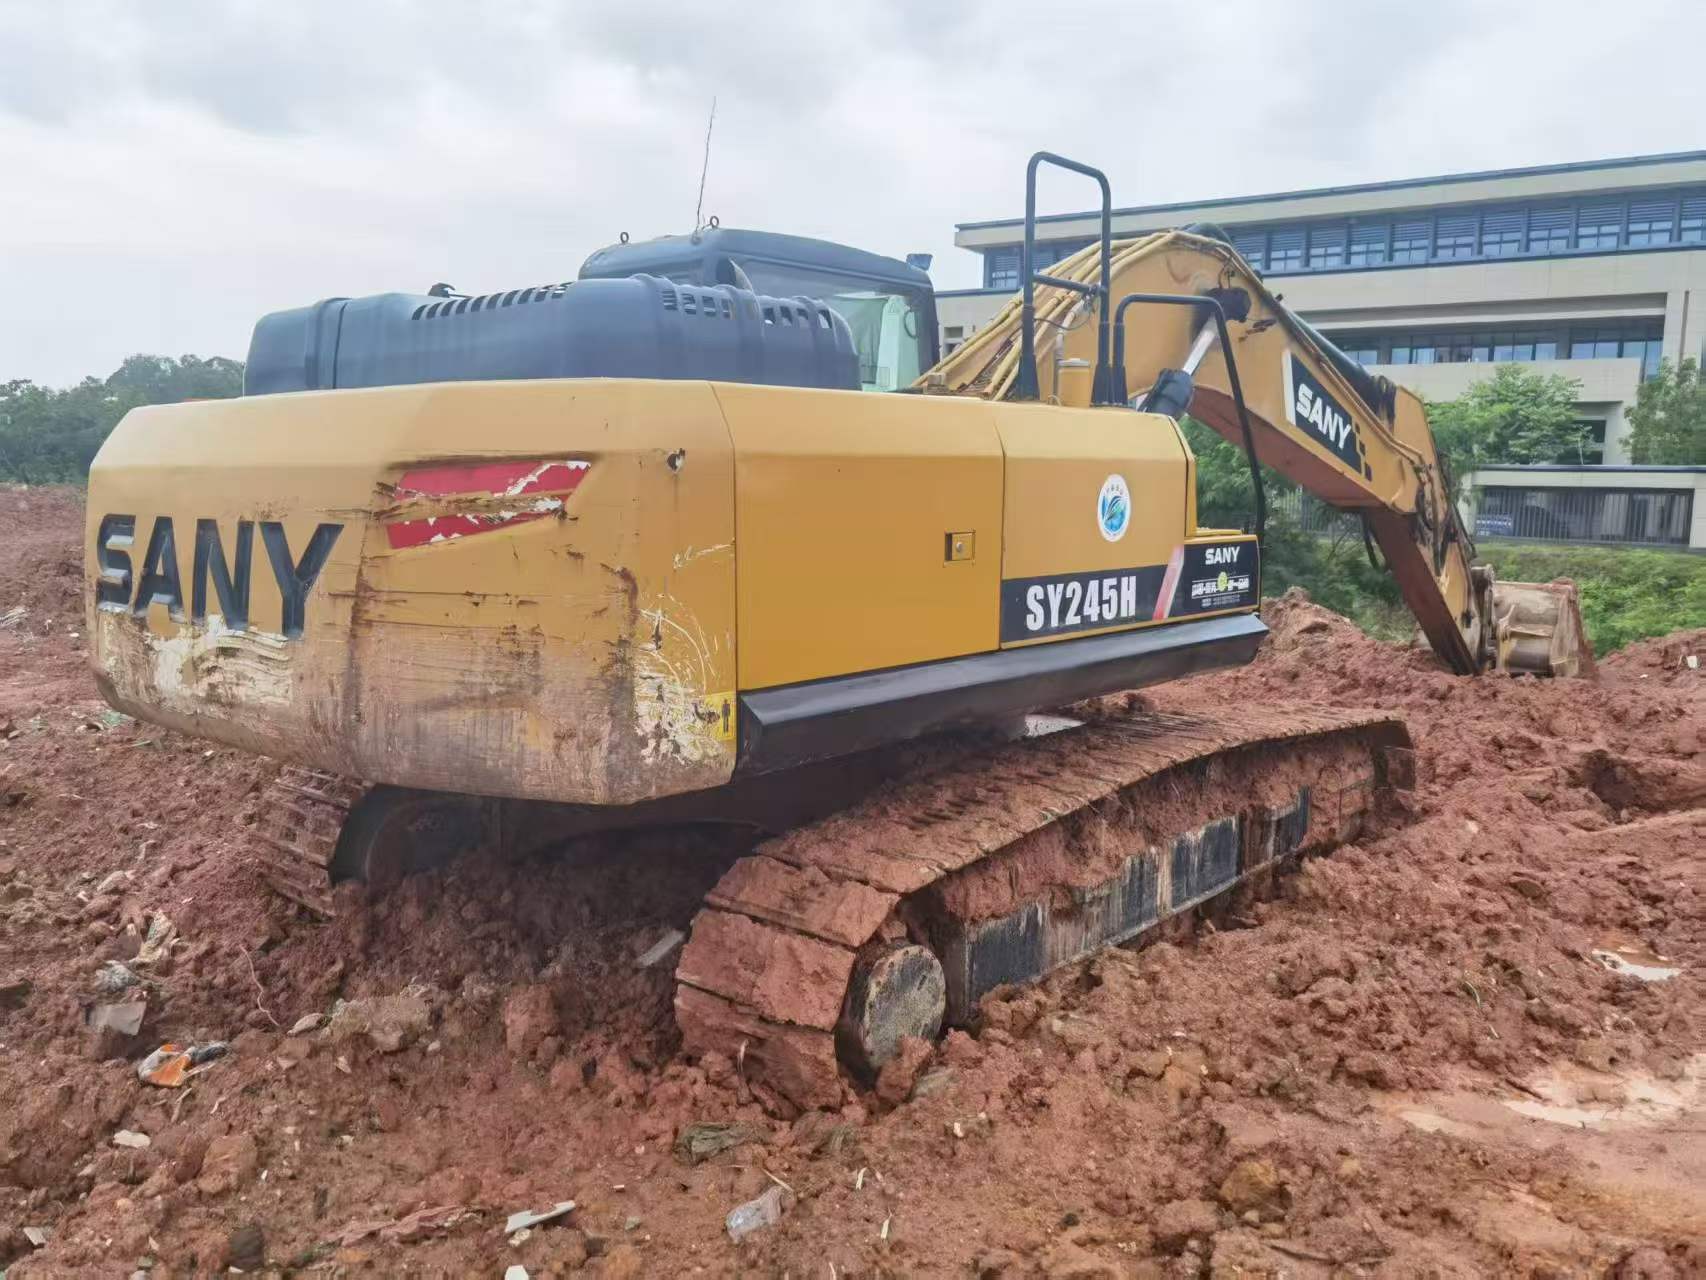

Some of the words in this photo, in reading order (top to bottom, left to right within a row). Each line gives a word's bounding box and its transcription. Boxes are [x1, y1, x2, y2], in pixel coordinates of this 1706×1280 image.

[1296, 383, 1352, 450] SANY
[96, 513, 344, 639] SANY
[1205, 546, 1240, 566] SANY
[1026, 576, 1137, 631] SY245H
